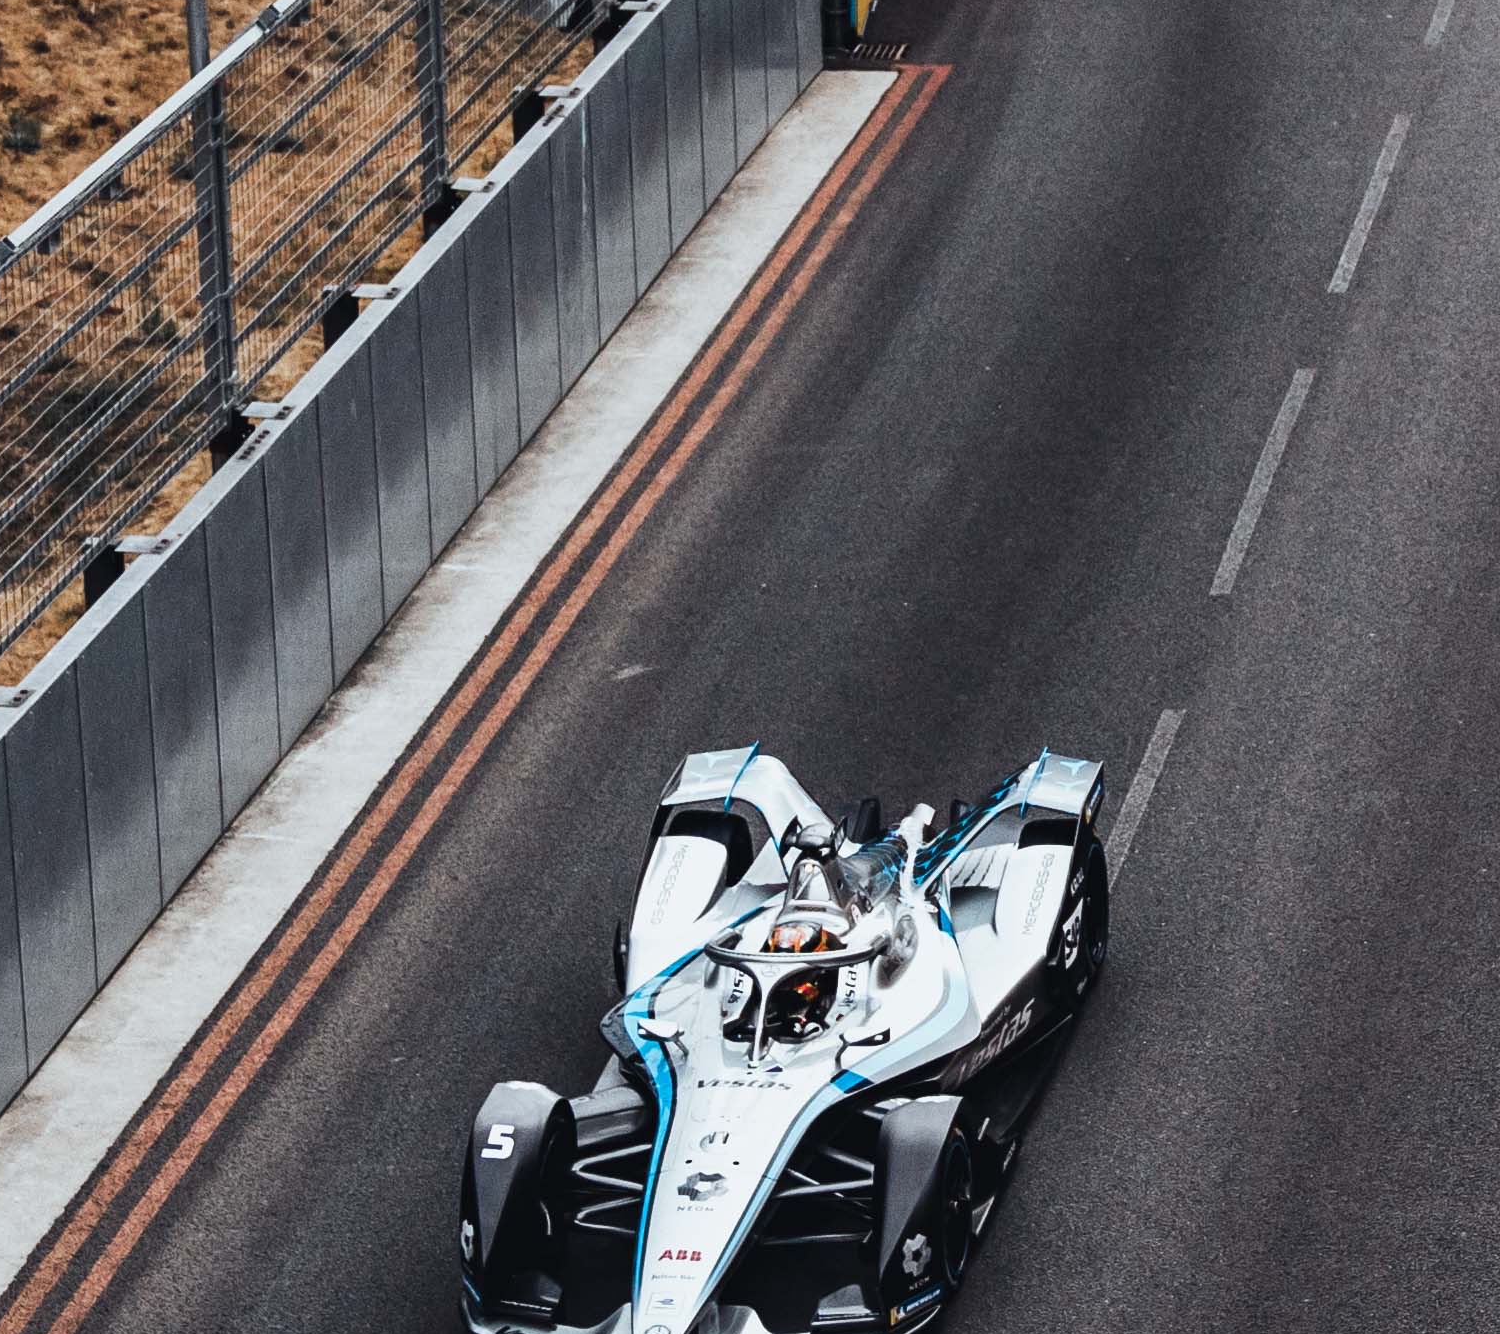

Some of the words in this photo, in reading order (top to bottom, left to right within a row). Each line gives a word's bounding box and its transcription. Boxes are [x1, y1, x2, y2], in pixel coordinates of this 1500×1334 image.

[698, 1078, 792, 1091] Vestas
[481, 1124, 515, 1159] 5
[658, 1250, 702, 1262] ABB
